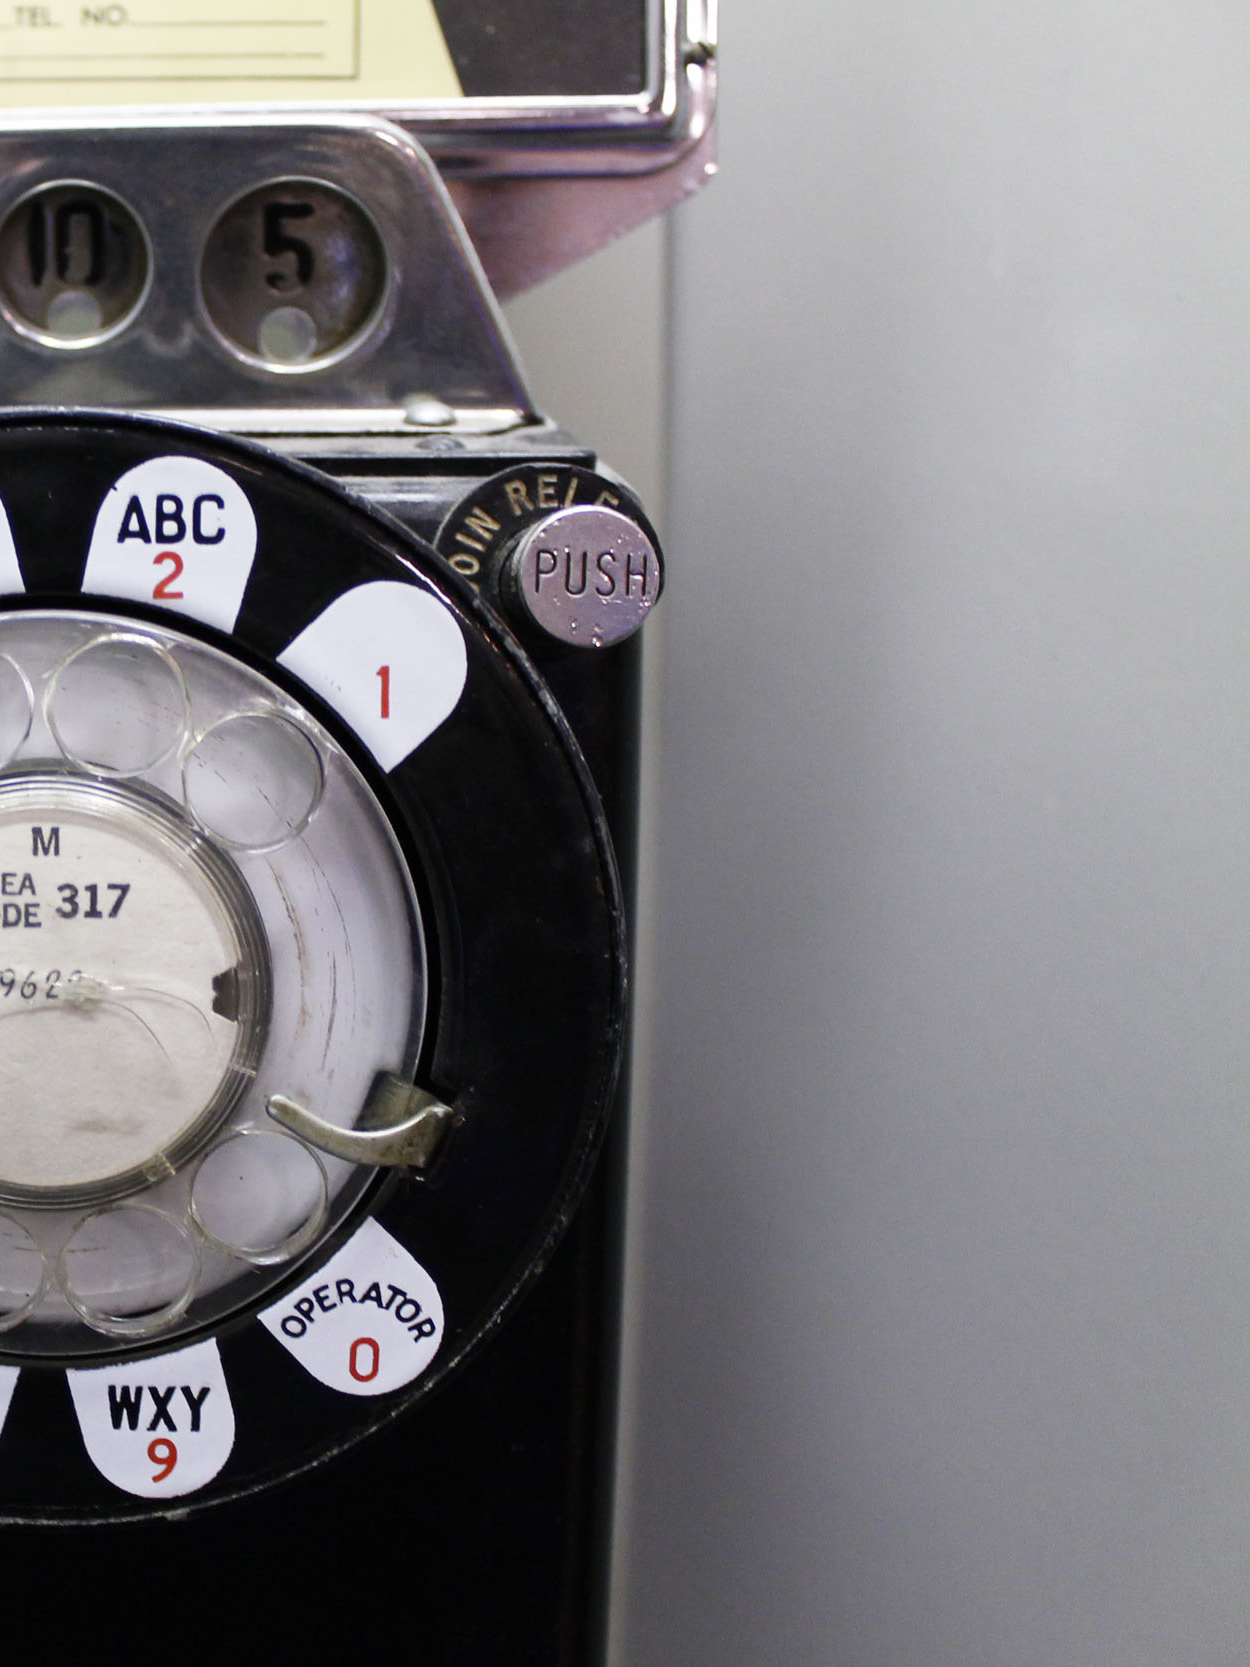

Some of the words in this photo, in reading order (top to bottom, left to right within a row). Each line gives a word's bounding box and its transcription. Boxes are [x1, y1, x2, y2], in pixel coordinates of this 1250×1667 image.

[27, 200, 105, 288] 10
[263, 202, 315, 294] 5
[117, 494, 225, 545] ABC
[449, 506, 502, 592] OIN
[535, 549, 648, 597] PUSH
[152, 551, 184, 600] 2
[376, 665, 391, 719] 1
[31, 827, 60, 857] M
[55, 883, 131, 919] 317
[280, 1278, 437, 1344] OPERATOR
[350, 1337, 380, 1383] 0
[108, 1385, 210, 1433] WXY
[147, 1437, 178, 1483] 9
